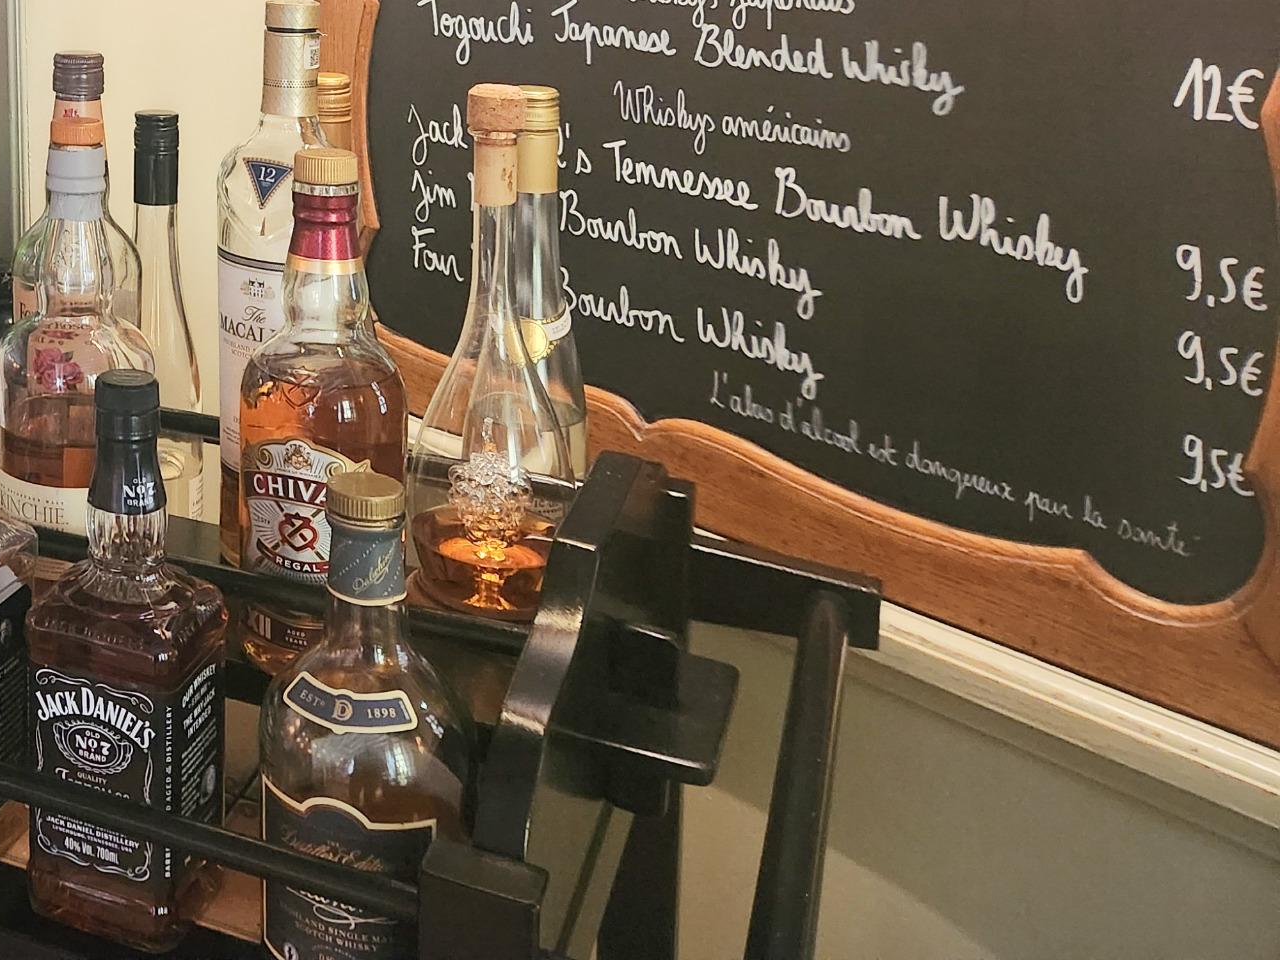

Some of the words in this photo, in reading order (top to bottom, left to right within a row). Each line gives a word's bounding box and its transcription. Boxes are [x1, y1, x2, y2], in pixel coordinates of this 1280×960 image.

[693, 23, 833, 79] Blended
[841, 40, 965, 117] Whisky
[1173, 57, 1265, 130] 12€
[613, 80, 716, 155] Whiskys
[260, 166, 276, 182] 12
[407, 103, 469, 167] Jack
[603, 140, 759, 211] Tennessee
[775, 167, 921, 240] Bourbon
[939, 194, 1089, 303] Whisky
[411, 170, 457, 222] Jim
[560, 190, 683, 260] Bourbon
[695, 228, 822, 320] Whisky
[1176, 244, 1269, 311] 9,5€
[244, 305, 267, 324] The
[411, 227, 464, 282] Four
[697, 307, 824, 399] Whisky
[1177, 330, 1264, 396] 9,5€
[1178, 434, 1254, 496] 9,5€
[275, 556, 320, 573] REGAL
[193, 663, 217, 691] WHISKEY
[36, 690, 77, 721] JACK
[81, 686, 156, 749] DANIEL'S
[367, 705, 397, 721] 1898
[86, 730, 101, 739] OLD
[79, 749, 107, 763] BRAND
[77, 771, 107, 786] QUALITY
[46, 815, 65, 828] JACK
[66, 820, 95, 837] DANIEL
[95, 829, 140, 849] DISTILLERY
[64, 836, 80, 855] 40%
[336, 938, 377, 953] WHISKY
